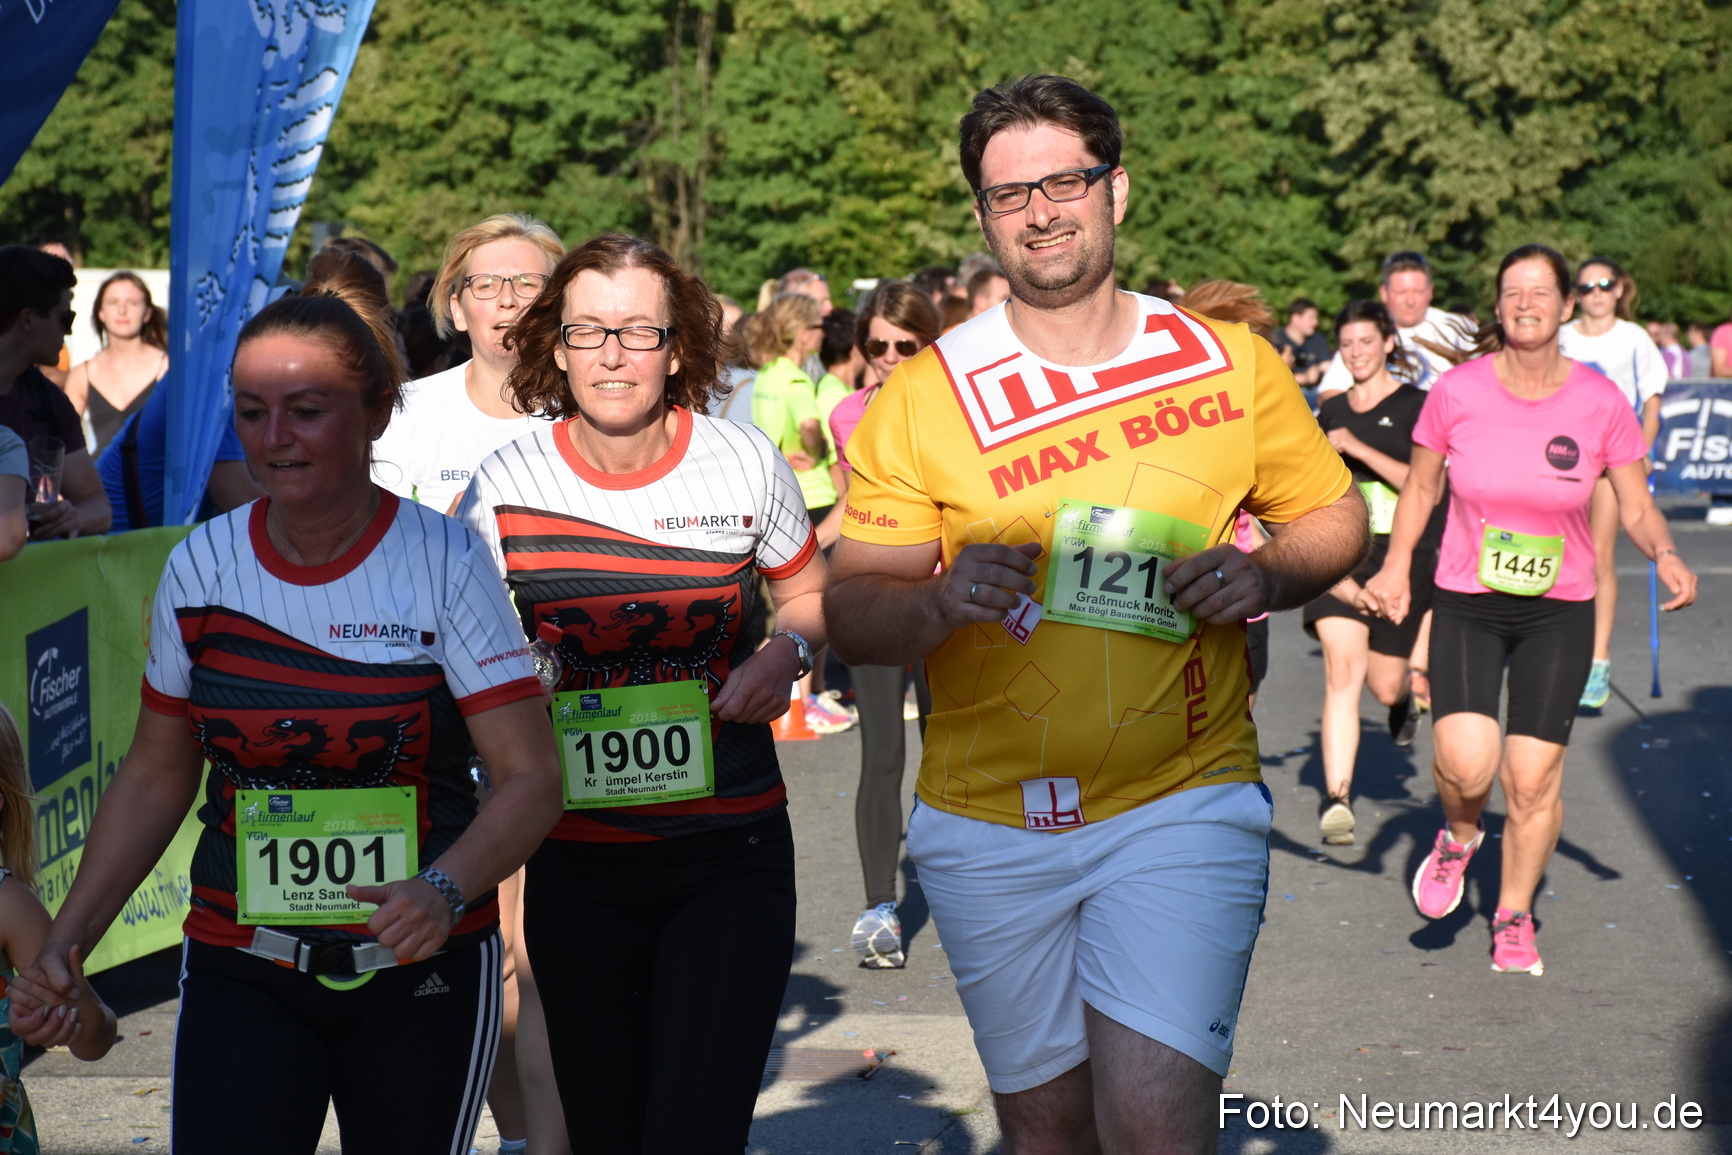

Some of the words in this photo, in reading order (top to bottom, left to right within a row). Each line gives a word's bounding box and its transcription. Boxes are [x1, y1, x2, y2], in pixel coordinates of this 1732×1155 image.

[988, 430, 1111, 499] MAX
[1119, 390, 1245, 450] BÖGL
[1664, 427, 1732, 462] Fis
[654, 515, 740, 531] NEUMARKT
[1139, 538, 1167, 552] 2018
[1491, 550, 1553, 578] 1445
[1073, 546, 1178, 606] 121
[1076, 591, 1141, 611] Graßmuck
[1144, 602, 1175, 619] Moritz
[1069, 603, 1086, 613] Max
[1088, 605, 1109, 617] Bögl
[1112, 609, 1156, 624] Bauservice
[1157, 618, 1178, 630] GmbH
[329, 624, 418, 643] NEUMARKT
[40, 666, 81, 706] Fischer
[572, 706, 623, 719] firmenlauf
[630, 712, 657, 723] 2018
[575, 725, 691, 774] 1900
[584, 777, 597, 788] Kr
[605, 773, 642, 788] ümpel
[645, 769, 688, 783] Kerstin
[605, 787, 626, 796] Stadt
[627, 784, 667, 795] Neumarkt
[258, 810, 316, 823] firmenlauf
[323, 820, 356, 832] 2018
[259, 836, 385, 886] 1901
[283, 889, 315, 901] Lenz
[289, 903, 313, 911] Stadt
[315, 901, 360, 911] Neumarkt
[414, 985, 450, 997] adidas
